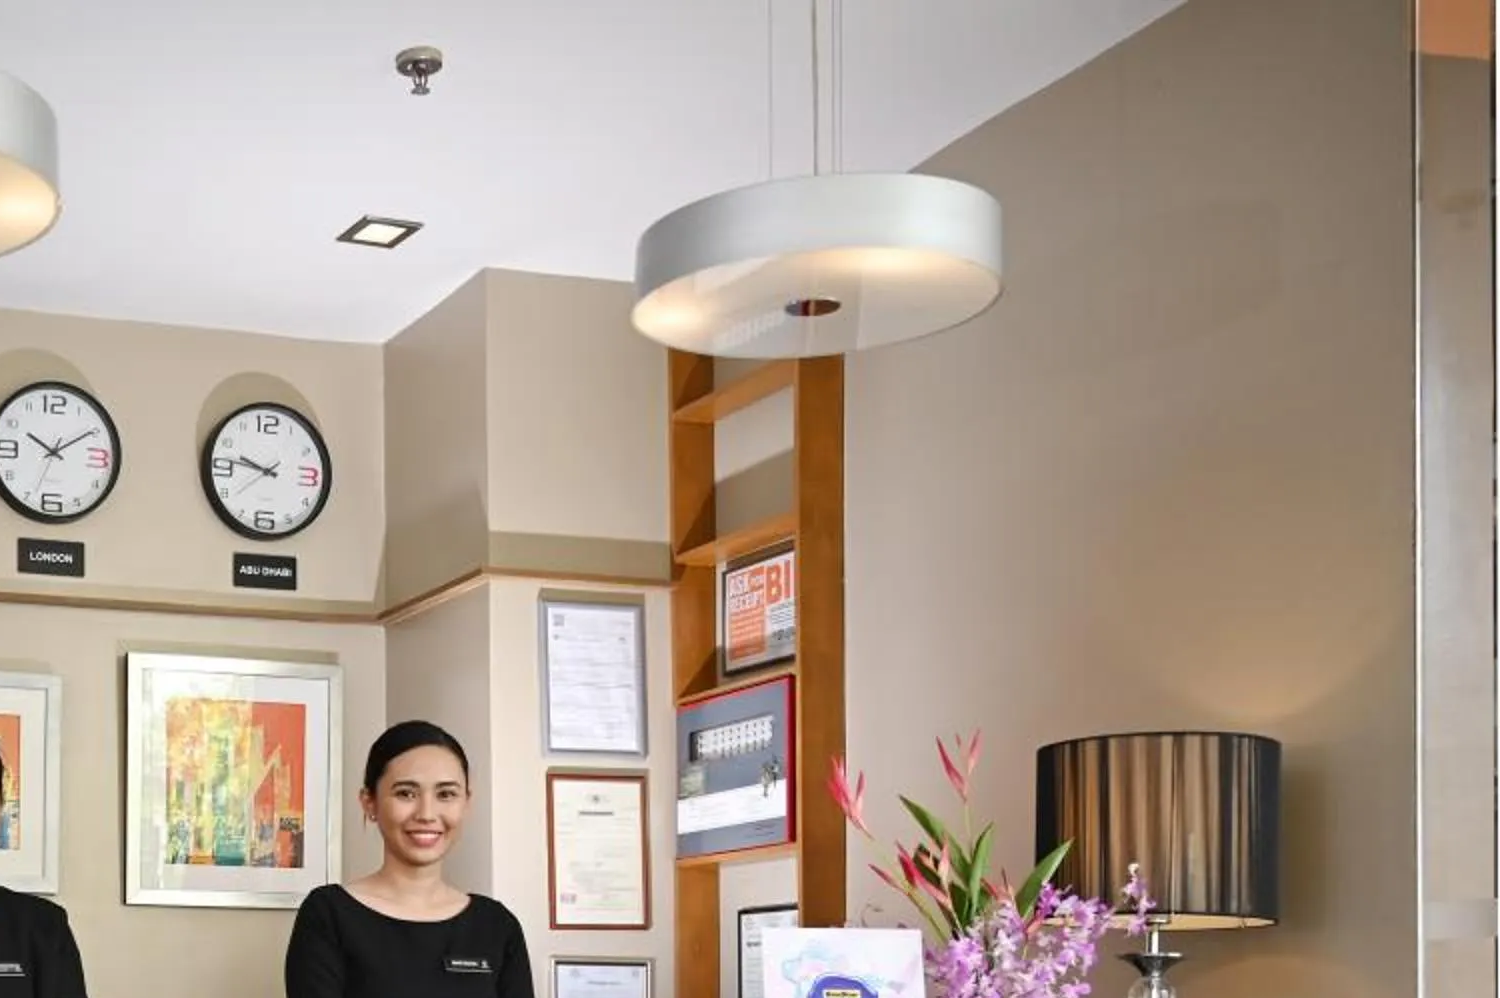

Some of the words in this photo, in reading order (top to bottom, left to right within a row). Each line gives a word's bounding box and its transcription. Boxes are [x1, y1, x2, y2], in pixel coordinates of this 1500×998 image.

[40, 394, 67, 415] 12
[256, 415, 280, 435] 12
[86, 447, 110, 469] 3
[213, 457, 233, 478] 9
[298, 466, 319, 487] 3
[40, 493, 63, 513] 6
[254, 511, 275, 530] 6
[29, 551, 73, 564] LONDON
[239, 565, 261, 576] ABU
[262, 566, 293, 578] DHABI
